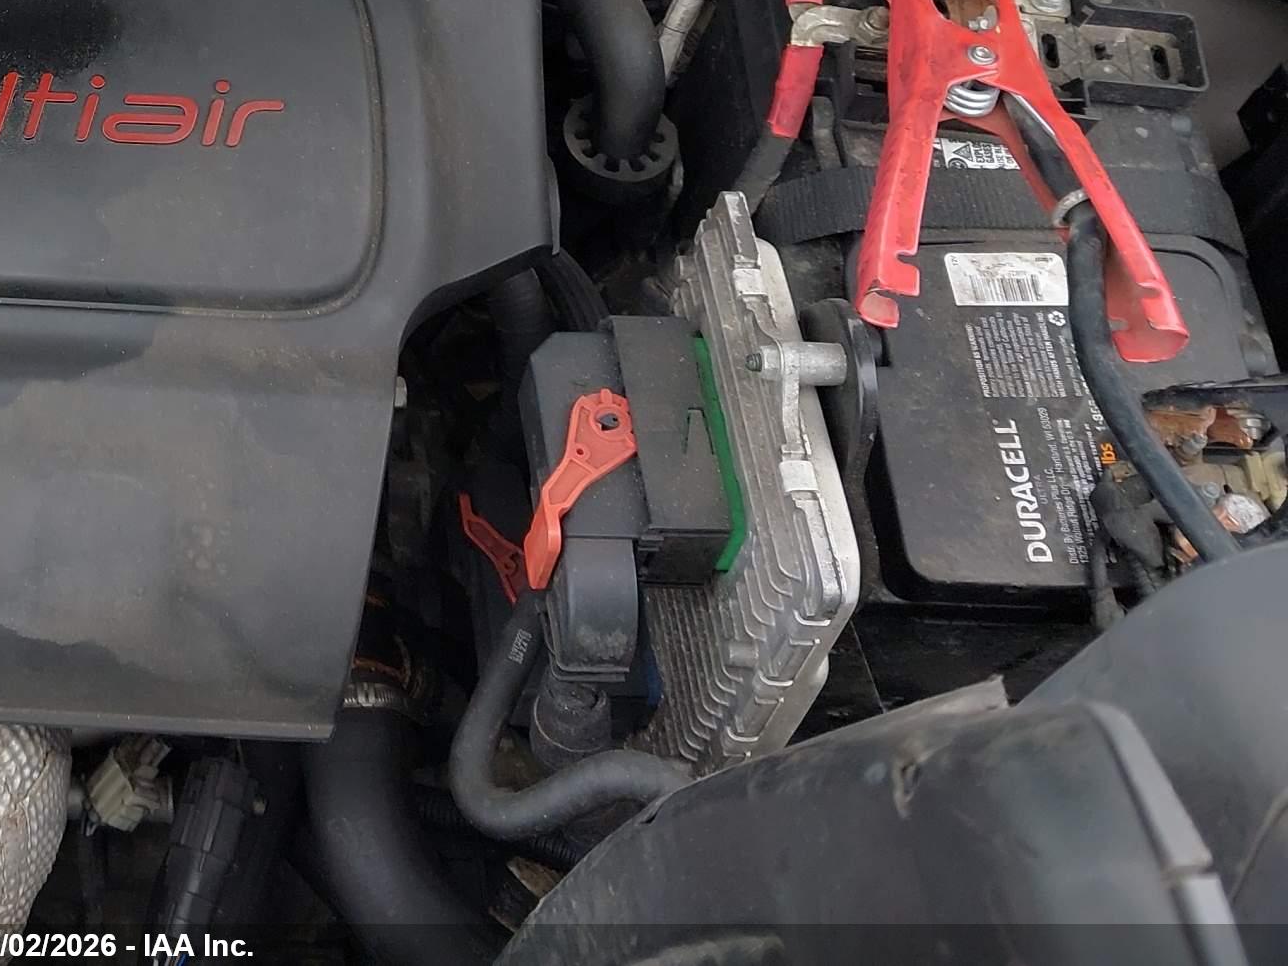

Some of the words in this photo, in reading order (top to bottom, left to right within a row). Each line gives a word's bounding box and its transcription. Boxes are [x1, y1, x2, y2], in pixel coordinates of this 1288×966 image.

[1044, 341, 1055, 358] AFTER
[974, 359, 991, 397] PROPOSITION
[1049, 360, 1061, 379] HANDS
[1036, 407, 1051, 429] 53029
[1043, 430, 1054, 440] WI
[995, 419, 1053, 562] DURACELL
[1034, 474, 1049, 505] ULTRA
[1048, 484, 1061, 499] Plus
[1054, 501, 1070, 531] Batteries
[1062, 496, 1078, 517] Ridge
[1062, 534, 1074, 542] By
[1068, 518, 1084, 543] Walnut
[1075, 545, 1089, 563] 1325
